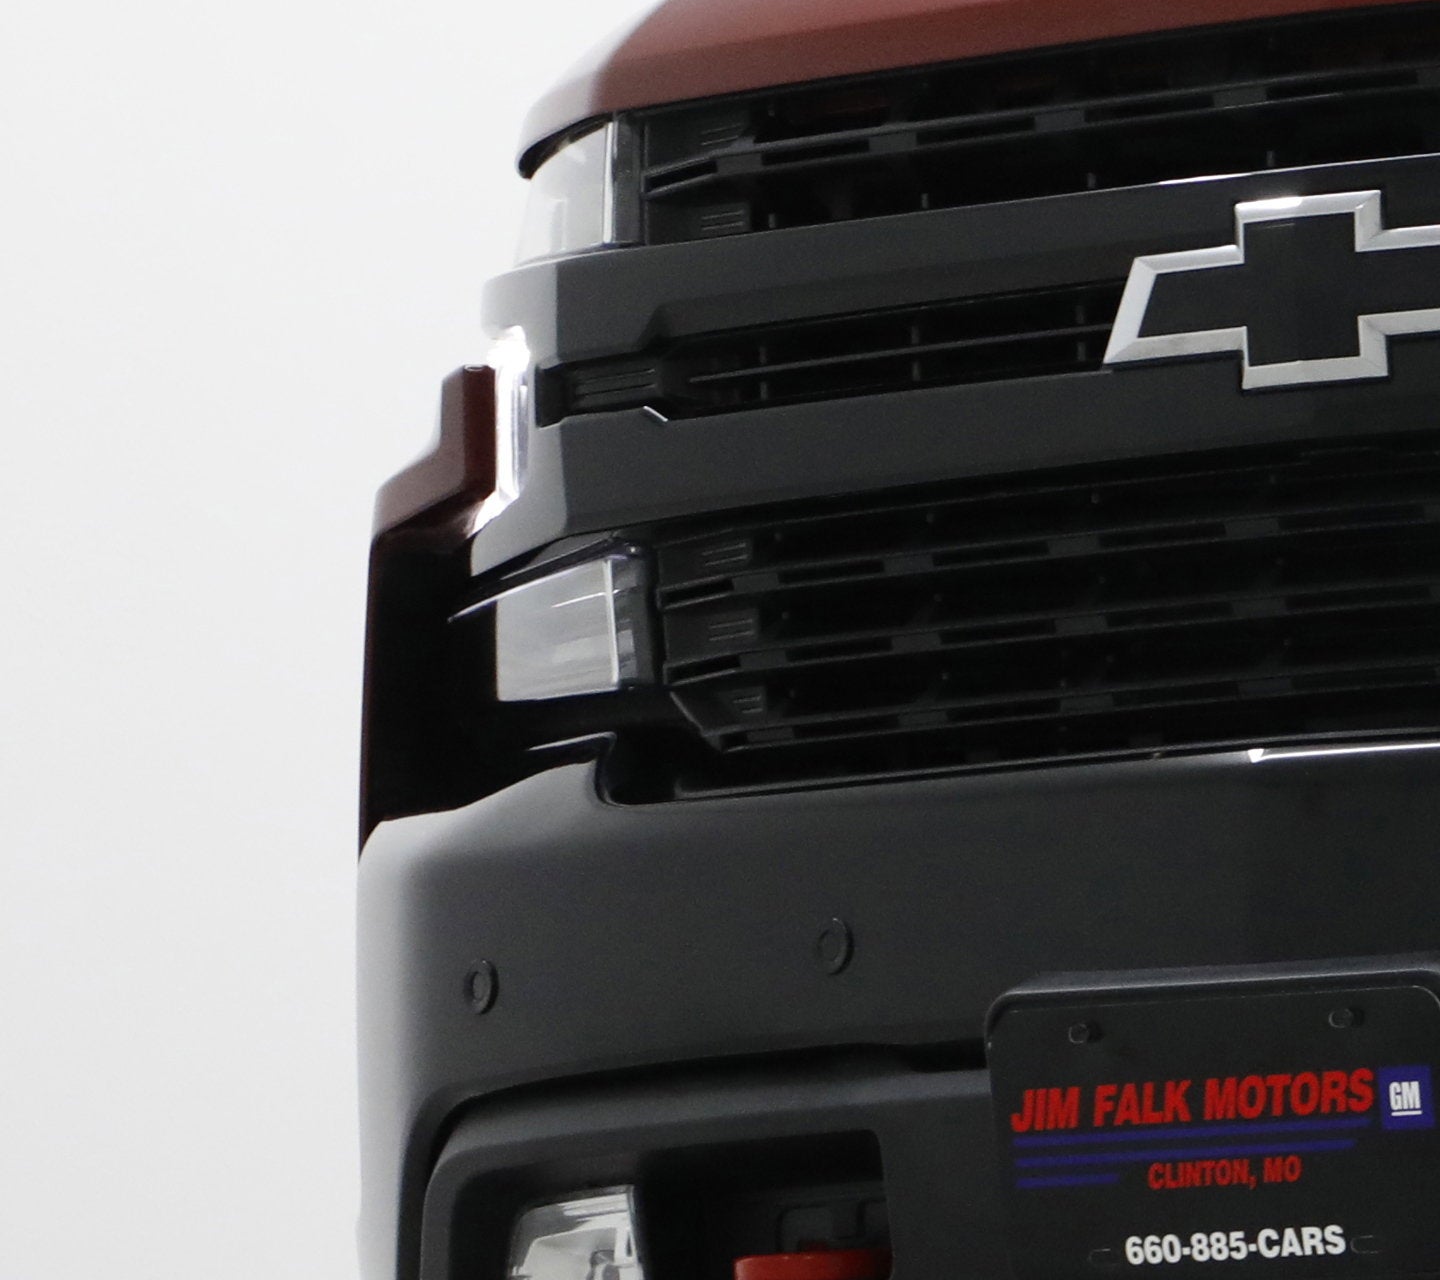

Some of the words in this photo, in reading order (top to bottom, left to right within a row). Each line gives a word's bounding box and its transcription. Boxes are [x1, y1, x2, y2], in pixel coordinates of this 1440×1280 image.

[1010, 1085, 1081, 1133] JIM
[1093, 1079, 1192, 1127] FALK
[1203, 1067, 1375, 1120] MOTORS
[1388, 1080, 1421, 1111] GM
[1147, 1157, 1258, 1191] CLINTON,
[1262, 1154, 1303, 1184] MO
[1125, 1224, 1347, 1266] 660-885-CARS
